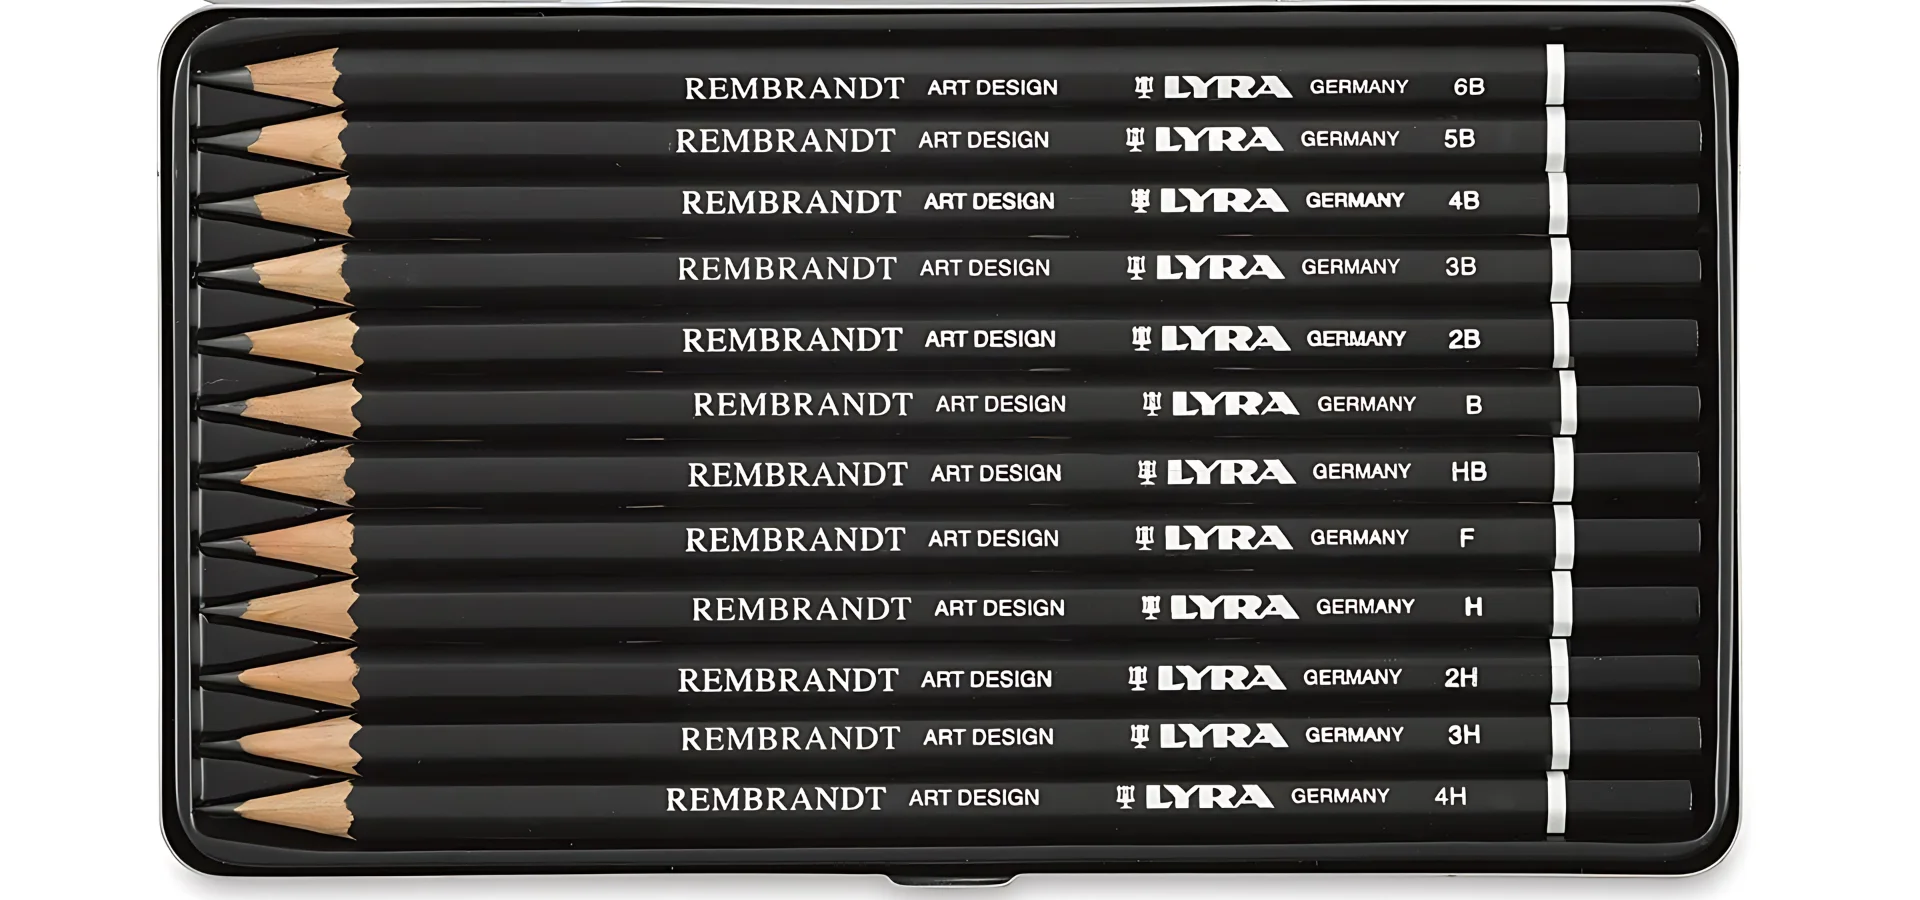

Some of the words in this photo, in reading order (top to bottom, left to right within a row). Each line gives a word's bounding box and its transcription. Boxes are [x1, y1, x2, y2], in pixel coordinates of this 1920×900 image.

[684, 76, 905, 100] REMBRANDT
[927, 78, 972, 96] ART
[976, 78, 1058, 96] DESIGN
[1164, 75, 1294, 99] LYRA
[1309, 78, 1409, 95] GERMANY
[1453, 77, 1486, 96] 6B
[675, 127, 897, 154] REMBRANDT
[918, 130, 963, 149] ART
[967, 130, 1049, 149] DESIGN
[1155, 126, 1285, 152] LYRA
[1300, 130, 1400, 148] GERMANY
[1444, 127, 1476, 149] 5B
[681, 189, 902, 215] REMBRANDT
[923, 191, 968, 211] ART
[972, 191, 1055, 211] DESIGN
[1160, 187, 1290, 213] LYRA
[1305, 191, 1406, 209] GERMANY
[1448, 190, 1480, 211] 4B
[678, 256, 898, 281] REMBRANDT
[919, 258, 964, 277] ART
[968, 258, 1050, 277] DESIGN
[1156, 254, 1286, 280] LYRA
[1301, 258, 1401, 276] GERMANY
[1445, 256, 1477, 277] 3B
[682, 326, 904, 353] REMBRANDT
[924, 329, 970, 349] ART
[973, 329, 1056, 349] DESIGN
[1161, 325, 1292, 352] LYRA
[1306, 329, 1407, 348] GERMANY
[1448, 328, 1481, 350] 2B
[693, 391, 914, 417] REMBRANDT
[935, 394, 980, 413] ART
[984, 394, 1066, 413] DESIGN
[1172, 390, 1301, 417] LYRA
[1317, 395, 1417, 413] GERMANY
[1465, 394, 1483, 415] B
[687, 461, 909, 488] REMBRANDT
[930, 463, 975, 483] ART
[979, 463, 1062, 483] DESIGN
[1167, 458, 1297, 485] LYRA
[1312, 462, 1412, 480] GERMANY
[1451, 460, 1488, 482] HB
[685, 526, 907, 553] REMBRANDT
[927, 528, 972, 548] ART
[976, 528, 1059, 548] DESIGN
[1164, 524, 1294, 551] LYRA
[1310, 528, 1410, 546] GERMANY
[1459, 527, 1475, 548] F
[692, 596, 913, 622] REMBRANDT
[934, 598, 978, 617] ART
[982, 598, 1065, 617] DESIGN
[1170, 594, 1300, 620] LYRA
[1316, 598, 1416, 615] GERMANY
[1464, 595, 1483, 617] H
[677, 667, 900, 693] REMBRANDT
[920, 669, 966, 689] ART
[970, 669, 1052, 689] DESIGN
[1157, 664, 1288, 691] LYRA
[1303, 668, 1403, 686] GERMANY
[1444, 666, 1478, 688] 2H
[681, 725, 901, 751] REMBRANDT
[922, 727, 967, 746] ART
[972, 727, 1054, 746] DESIGN
[1159, 722, 1290, 749] LYRA
[1305, 726, 1405, 744] GERMANY
[1448, 723, 1481, 746] 3H
[666, 786, 887, 812] REMBRANDT
[908, 788, 953, 807] ART
[957, 788, 1040, 807] DESIGN
[1145, 783, 1275, 810] LYRA
[1290, 787, 1391, 804] GERMANY
[1434, 786, 1467, 806] 4H
